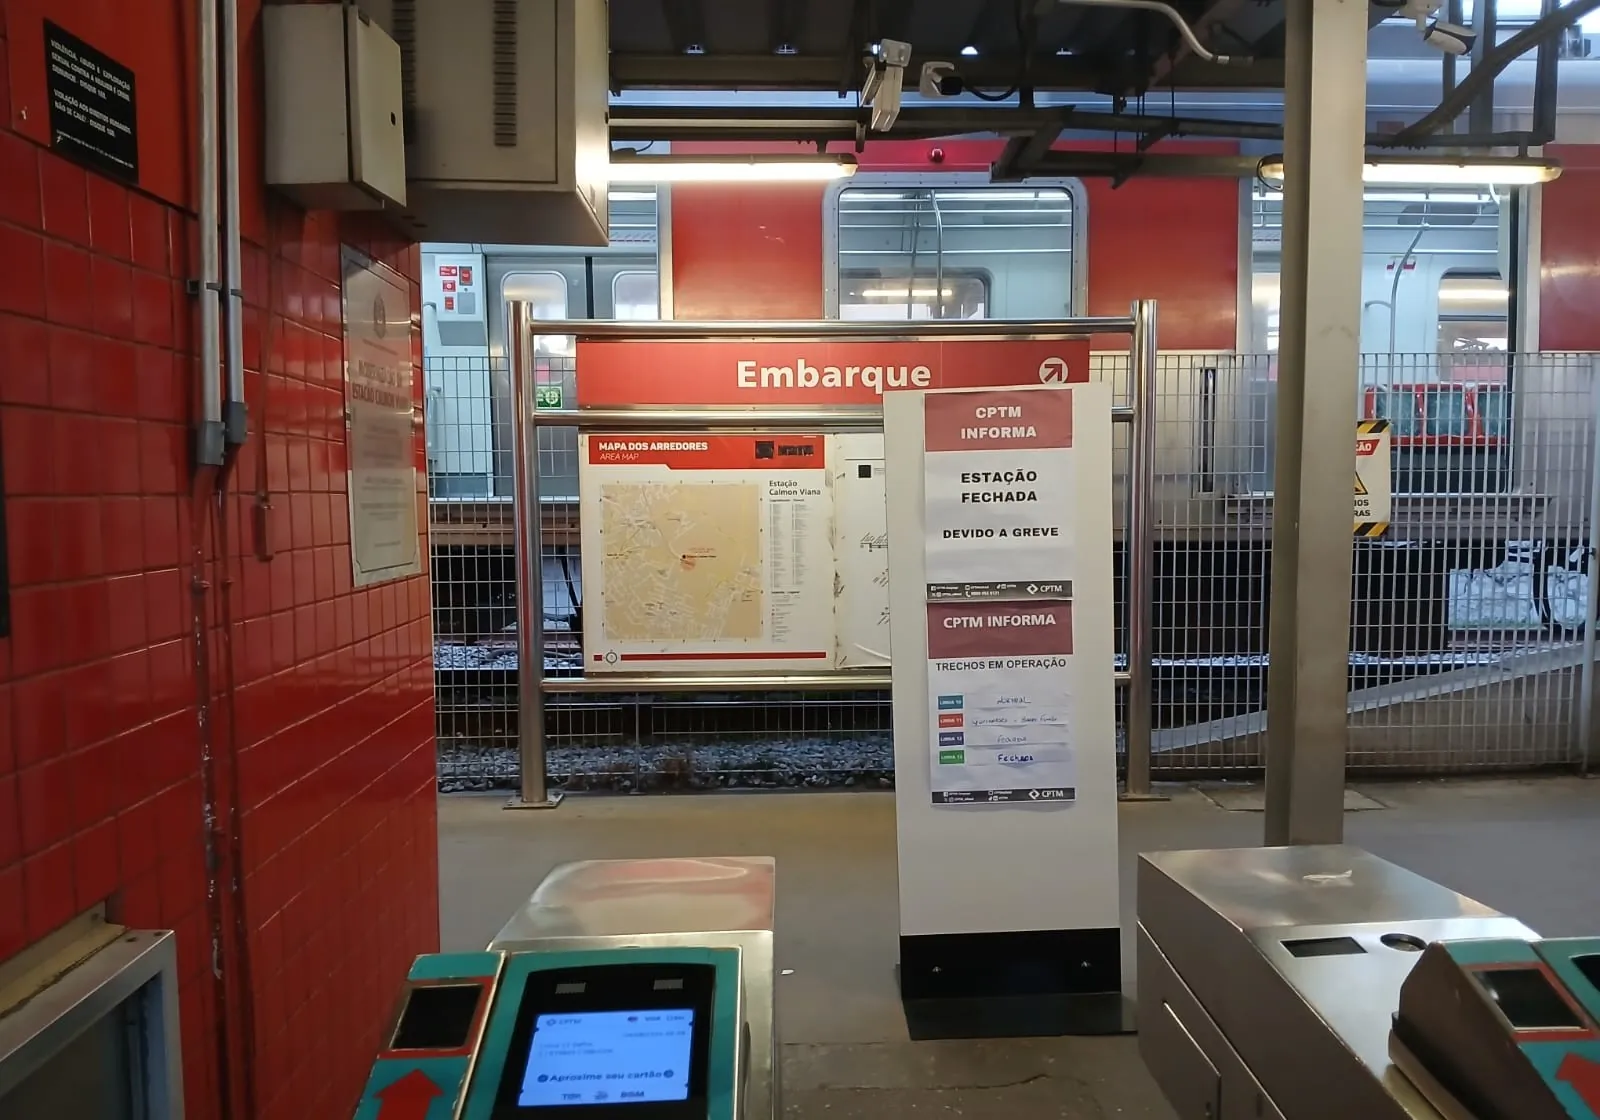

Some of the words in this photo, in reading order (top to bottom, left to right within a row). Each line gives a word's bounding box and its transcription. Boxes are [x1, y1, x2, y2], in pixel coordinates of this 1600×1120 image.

[737, 360, 931, 394] Embarque
[976, 406, 1022, 419] CPTM
[961, 426, 1037, 440] INFORMA
[599, 442, 627, 451] MAPA
[628, 442, 649, 451] DOS
[650, 442, 708, 450] ARREDORES
[600, 452, 621, 461] AREA
[622, 452, 640, 460] MAP
[961, 468, 1038, 486] ESTAÇÃO
[769, 480, 798, 488] Estação
[769, 488, 798, 496] Calmon
[800, 488, 821, 496] Viana
[961, 490, 1038, 504] FECHADA
[943, 529, 994, 539] DEVIDO
[999, 529, 1008, 538] A
[1012, 527, 1059, 537] GREVE
[1040, 584, 1063, 593] CPTM
[944, 616, 983, 628] CPTM
[988, 614, 1056, 627] INFORMA
[936, 661, 985, 671] TRECHOS
[988, 660, 1004, 670] EM
[1006, 656, 1067, 670] OPERAÇÃO
[1042, 790, 1064, 798] CPTM
[549, 1071, 602, 1082] Aproxime
[606, 1072, 625, 1080] seu
[627, 1070, 662, 1080] cartão
